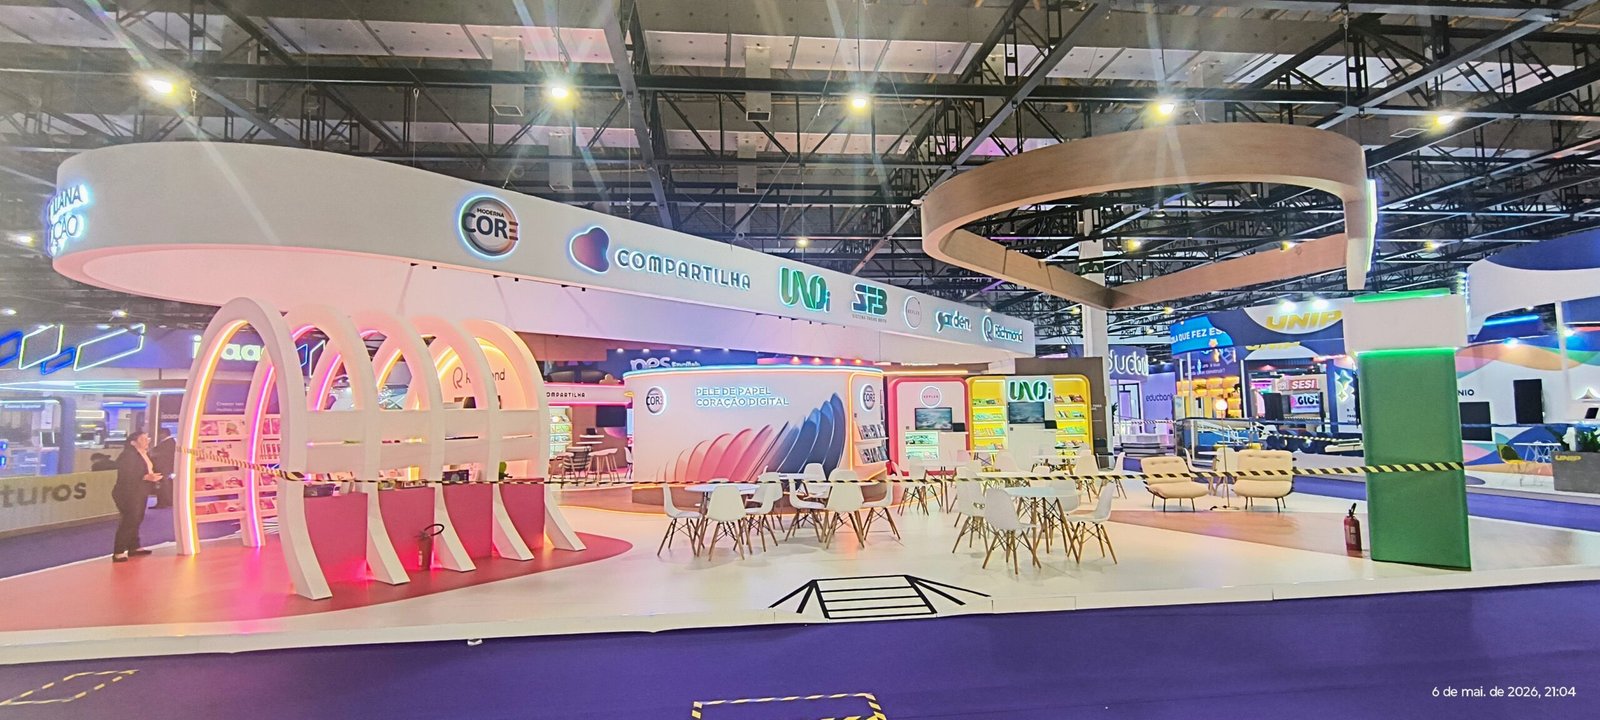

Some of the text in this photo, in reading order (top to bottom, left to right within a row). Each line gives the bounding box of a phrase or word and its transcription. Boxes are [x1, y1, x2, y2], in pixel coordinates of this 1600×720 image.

[477, 207, 505, 218] MODERNA
[462, 213, 519, 241] CORE
[616, 250, 751, 289] COMPARTILHA
[1266, 310, 1343, 330] UNIP
[994, 324, 1024, 342] Richmond
[1179, 331, 1191, 341] QUE
[1191, 328, 1208, 339] FEZ
[1291, 380, 1315, 389] SESI
[696, 387, 771, 396] PELE DE PAPEL
[696, 396, 790, 407] CORAÇÃO DIGITAL
